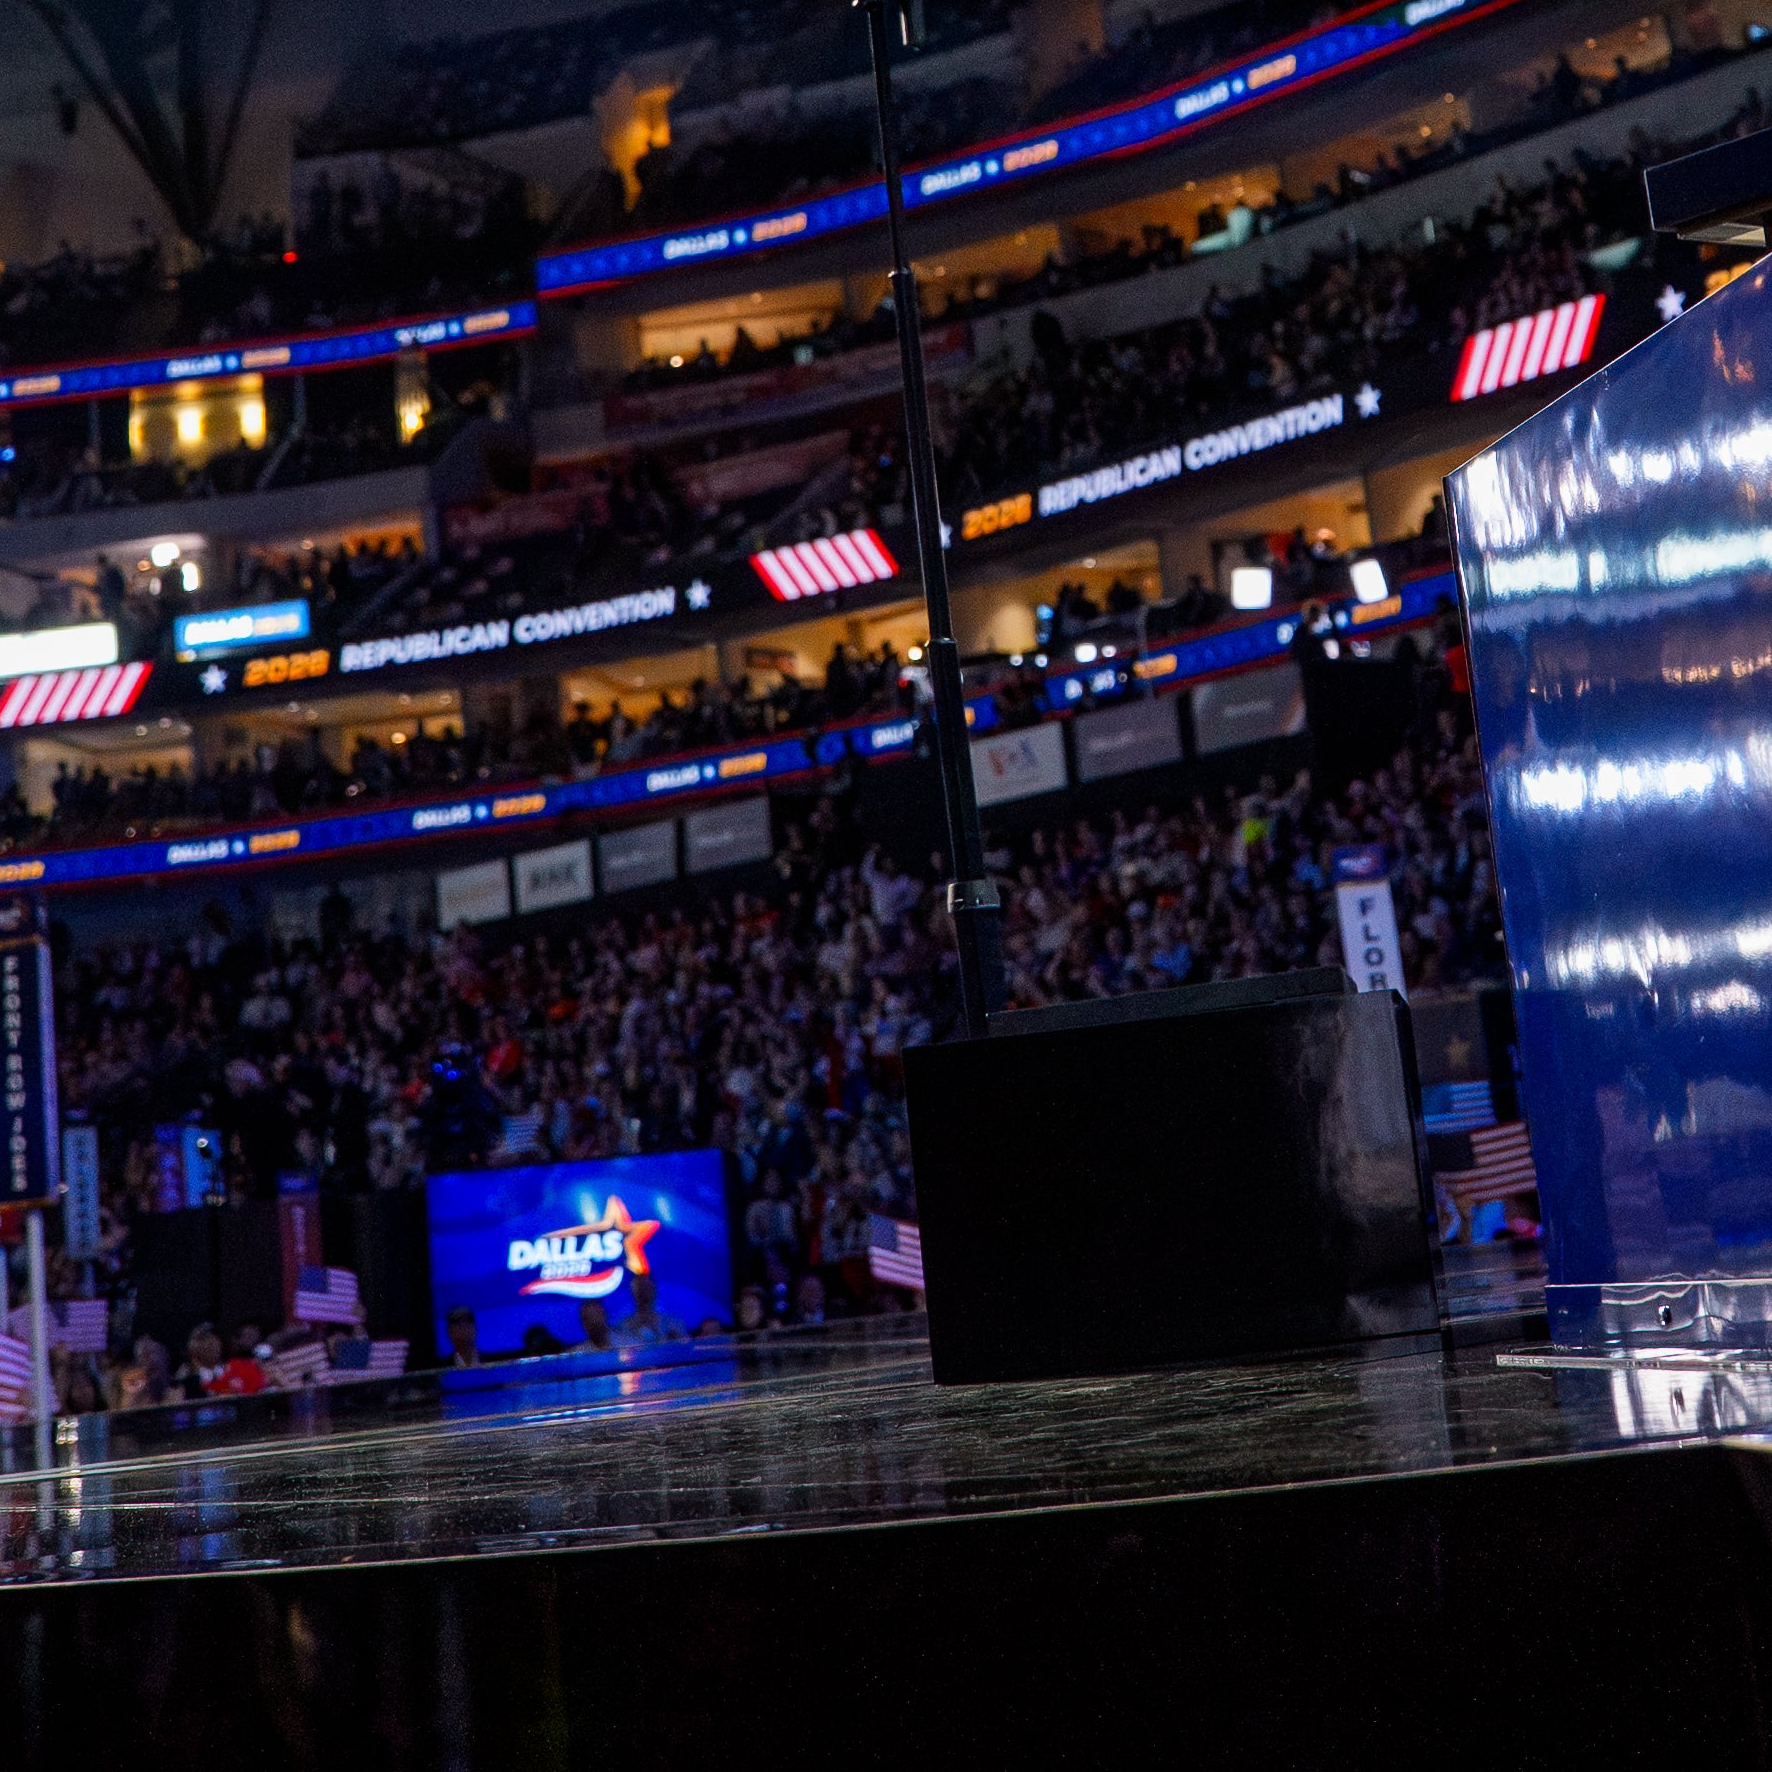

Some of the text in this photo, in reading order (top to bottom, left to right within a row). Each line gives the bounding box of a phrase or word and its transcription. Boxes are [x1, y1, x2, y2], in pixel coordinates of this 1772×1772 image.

[1039, 448, 1181, 517] REPUBLICAN
[1184, 394, 1343, 470] CONVENTION
[340, 620, 510, 672] REPUBLICAN
[513, 587, 675, 644] CONVENTION
[2, 955, 20, 1048] FRONT
[5, 1054, 26, 1111] ROW
[505, 1226, 626, 1274] DALLAS
